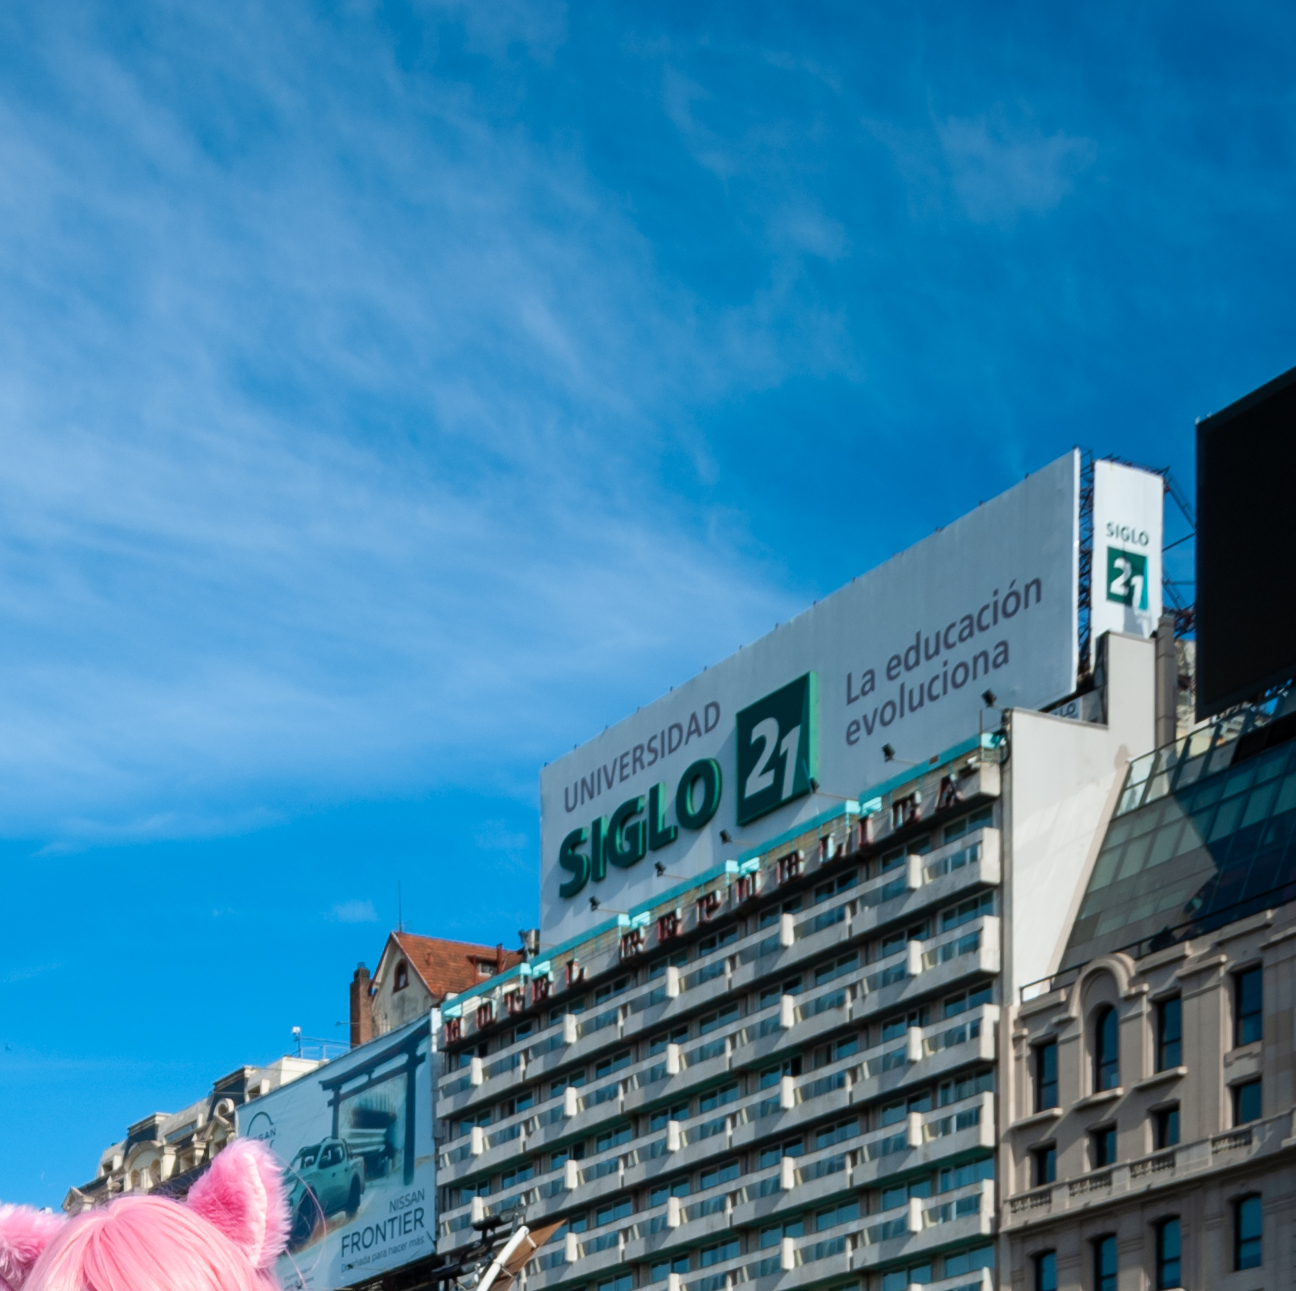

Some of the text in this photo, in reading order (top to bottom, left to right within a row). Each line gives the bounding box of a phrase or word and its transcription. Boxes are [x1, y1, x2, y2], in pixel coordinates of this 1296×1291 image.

[1106, 522, 1149, 547] SIGLO
[1110, 557, 1144, 615] 21
[846, 577, 1042, 706] La educación
[845, 639, 1010, 746] evoluciona
[563, 701, 722, 814] UNIVERSIDAD
[558, 715, 802, 899] SIGLO 21
[389, 1187, 425, 1213] NISSAN
[341, 1206, 425, 1257] FRONTIER
[372, 1249, 388, 1263] para
[388, 1241, 408, 1255] hacer
